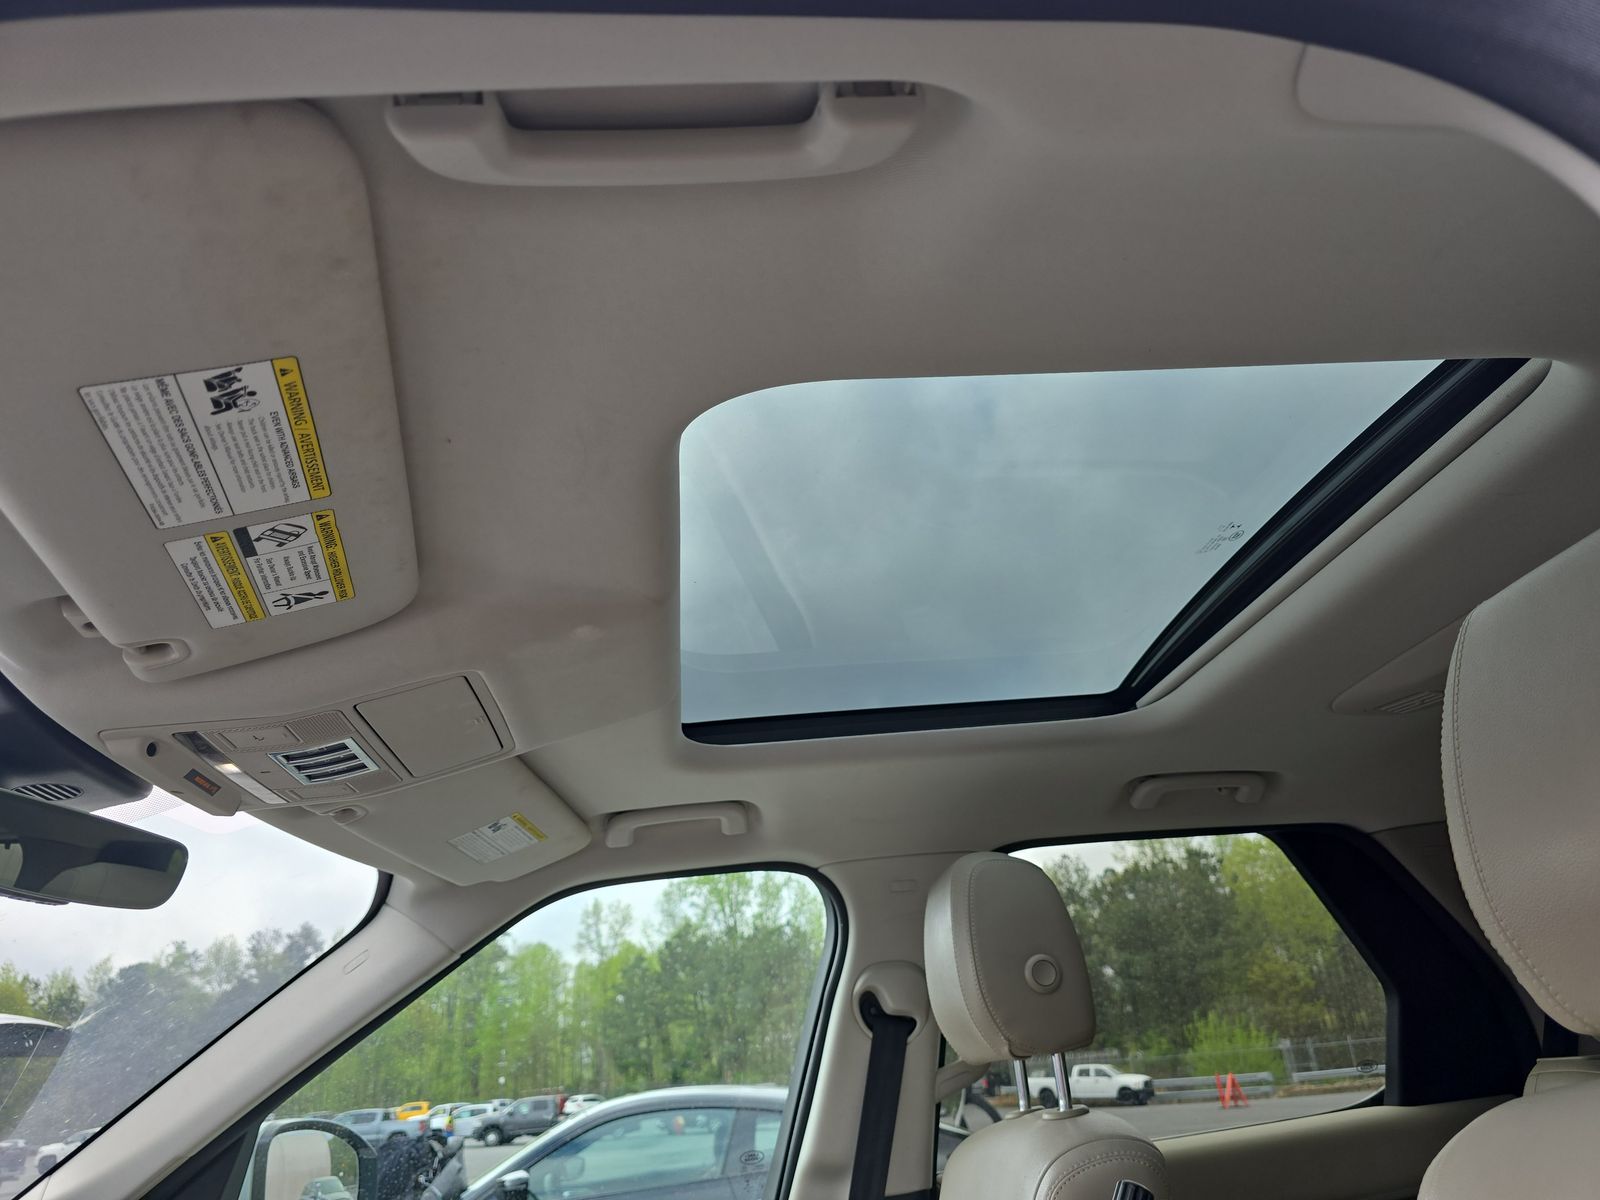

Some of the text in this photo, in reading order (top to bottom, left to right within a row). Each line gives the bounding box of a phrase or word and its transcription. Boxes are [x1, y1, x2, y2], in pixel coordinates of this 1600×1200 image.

[154, 377, 173, 397] MÊME
[163, 397, 180, 414] AVEC
[170, 414, 185, 426] DES
[176, 427, 192, 443] SACS
[282, 380, 307, 426] WARNING
[297, 431, 325, 492] AVERTISSEMENT
[183, 442, 208, 477] GONFLABLES
[268, 410, 301, 488] EVEN WITH ADVANCED AIRBAGS
[318, 520, 338, 551] WARNING:
